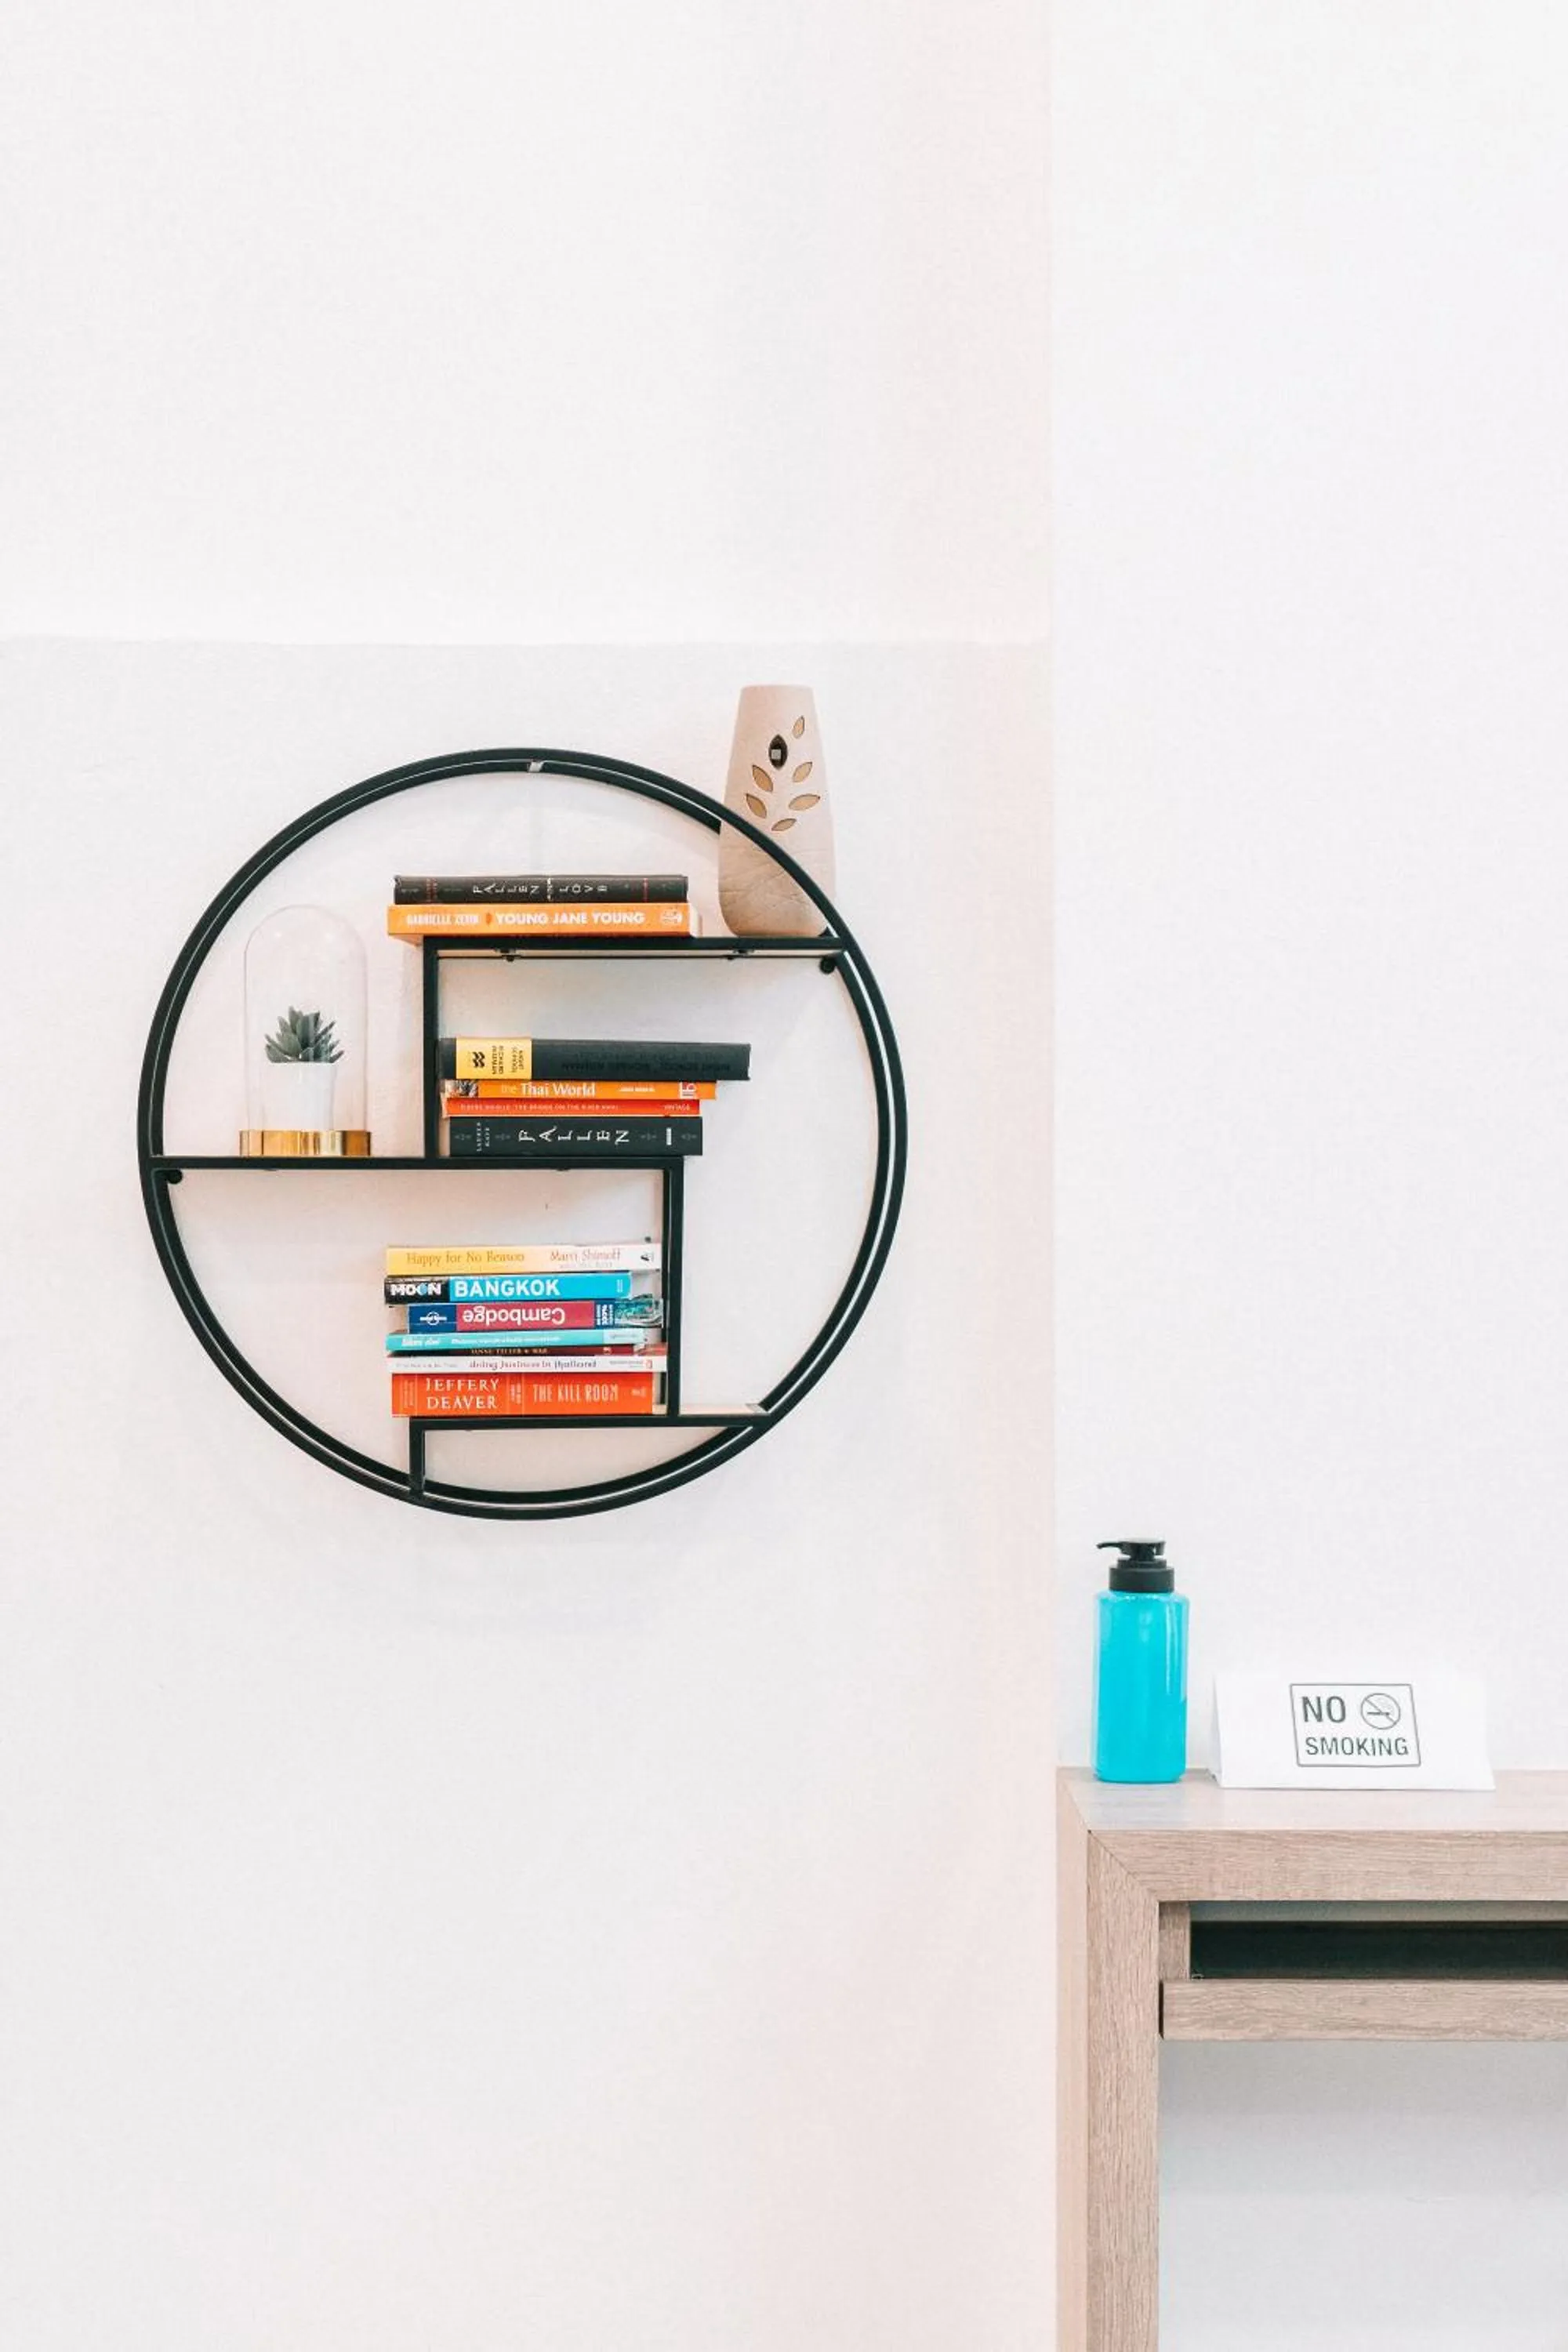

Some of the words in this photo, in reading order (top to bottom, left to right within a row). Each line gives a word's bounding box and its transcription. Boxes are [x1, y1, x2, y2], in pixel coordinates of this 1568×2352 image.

[495, 911, 548, 925] YOUNG
[553, 911, 588, 925] JANE
[592, 911, 646, 925] YOUNG
[521, 1082, 550, 1095] Thai
[552, 1082, 597, 1095] World
[518, 1126, 630, 1145] FALLEN
[407, 1252, 441, 1267] Happy
[446, 1250, 461, 1262] for
[466, 1252, 481, 1262] No
[487, 1250, 524, 1262] Reason
[391, 1282, 441, 1296] MOON
[454, 1279, 561, 1298] BANGKOK
[462, 1305, 565, 1326] Cambodge
[426, 1377, 499, 1392] JEFFERY
[533, 1383, 554, 1403] THE
[558, 1383, 581, 1403] KILL
[585, 1382, 619, 1403] ROOM
[426, 1396, 498, 1410] DEAVER
[1301, 1696, 1346, 1723] NO
[1305, 1737, 1409, 1756] SMOKING
